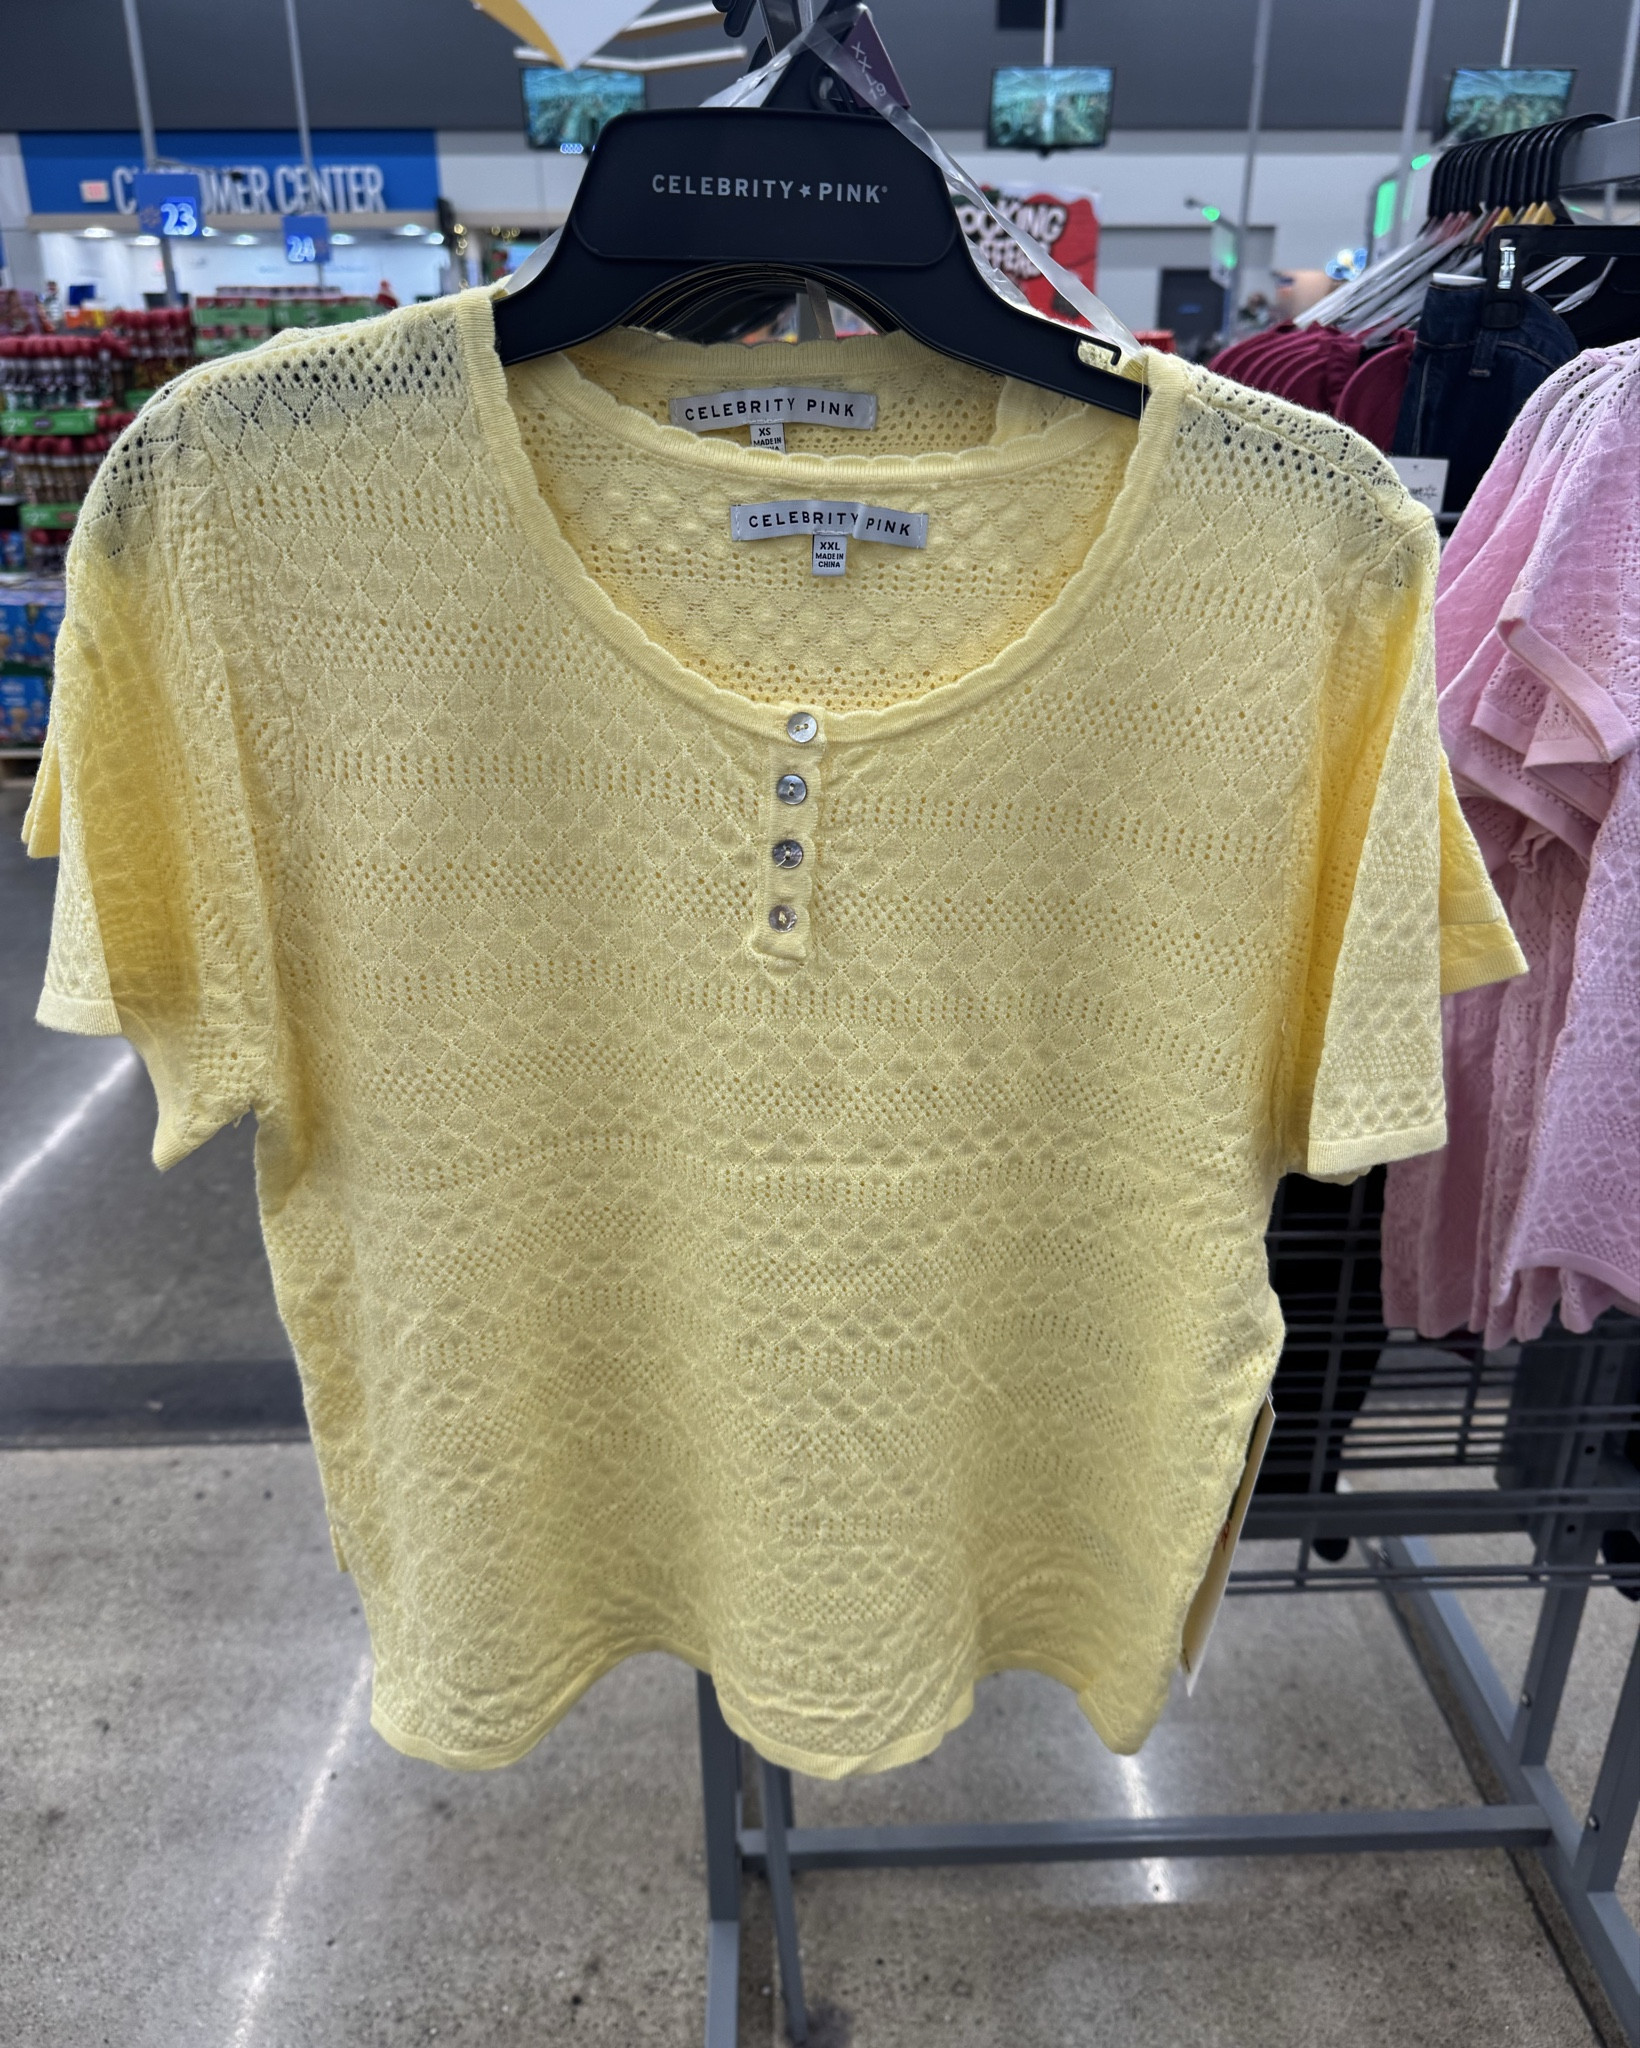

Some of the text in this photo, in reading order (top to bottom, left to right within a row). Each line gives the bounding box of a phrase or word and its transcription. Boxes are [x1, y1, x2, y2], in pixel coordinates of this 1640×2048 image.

[652, 174, 794, 199] CELEBRITY
[160, 202, 198, 236] 23
[685, 398, 855, 421] CELEBRITY PINK
[758, 427, 771, 437] XS
[749, 511, 911, 536] CELEBRITY PINK
[819, 541, 841, 551] XXL
[815, 552, 844, 560] MADE IN
[818, 561, 840, 569] CHINA
